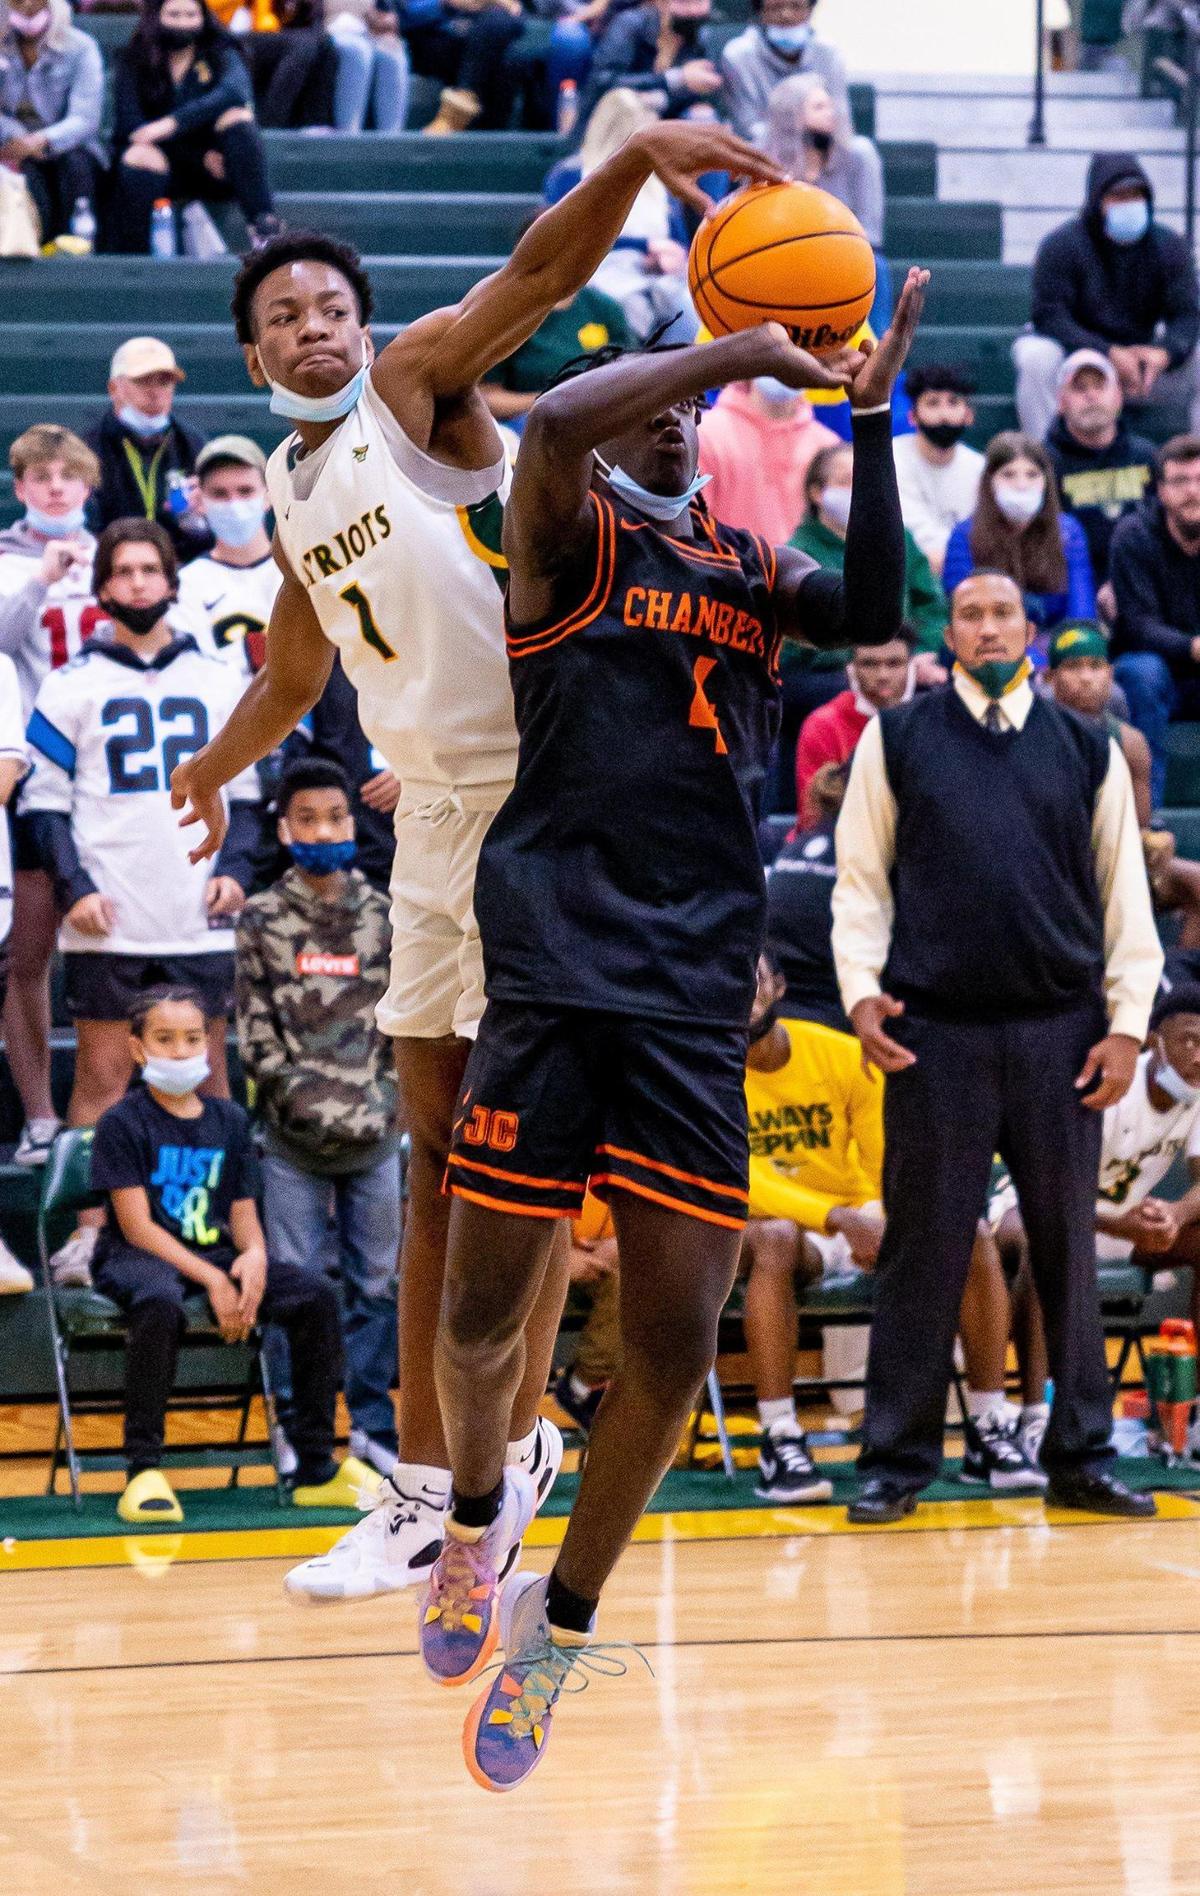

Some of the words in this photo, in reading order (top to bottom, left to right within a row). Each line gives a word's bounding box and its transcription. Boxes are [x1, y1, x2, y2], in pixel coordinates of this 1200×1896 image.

[303, 504, 392, 586] TRIOTS
[338, 580, 400, 664] 1
[622, 586, 766, 657] CHAMBER
[463, 1104, 519, 1152] JC
[749, 1102, 832, 1134] WAYS
[750, 1127, 831, 1156] EPPIN
